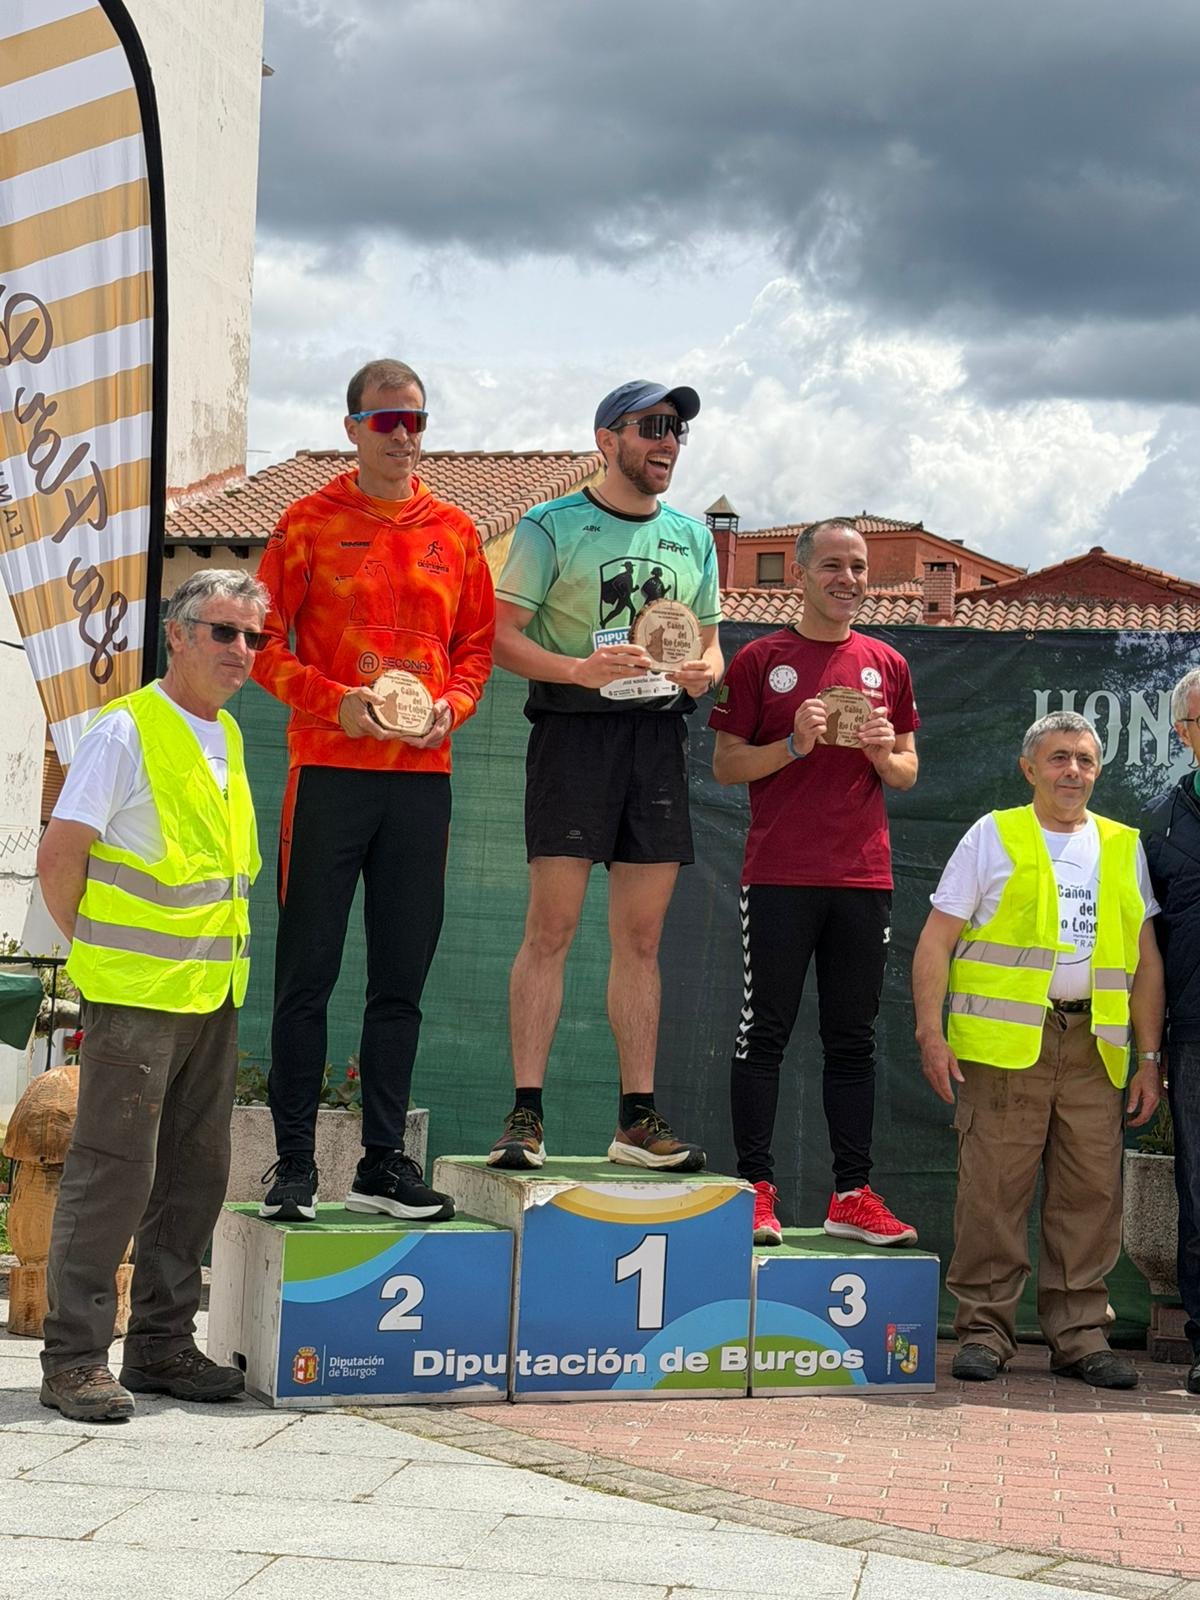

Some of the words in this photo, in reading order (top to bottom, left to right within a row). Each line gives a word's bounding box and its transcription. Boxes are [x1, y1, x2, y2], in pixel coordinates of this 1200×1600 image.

[1057, 884, 1092, 900] Cañón
[1079, 902, 1097, 917] del
[615, 1233, 668, 1331] 1
[377, 1273, 425, 1332] 2
[827, 1272, 868, 1329] 3
[328, 1367, 341, 1378] de
[342, 1367, 377, 1379] Burgos
[329, 1355, 385, 1370] Diputación
[412, 1348, 647, 1382] Diputación
[659, 1346, 710, 1374] de
[720, 1346, 865, 1377] Burgos
